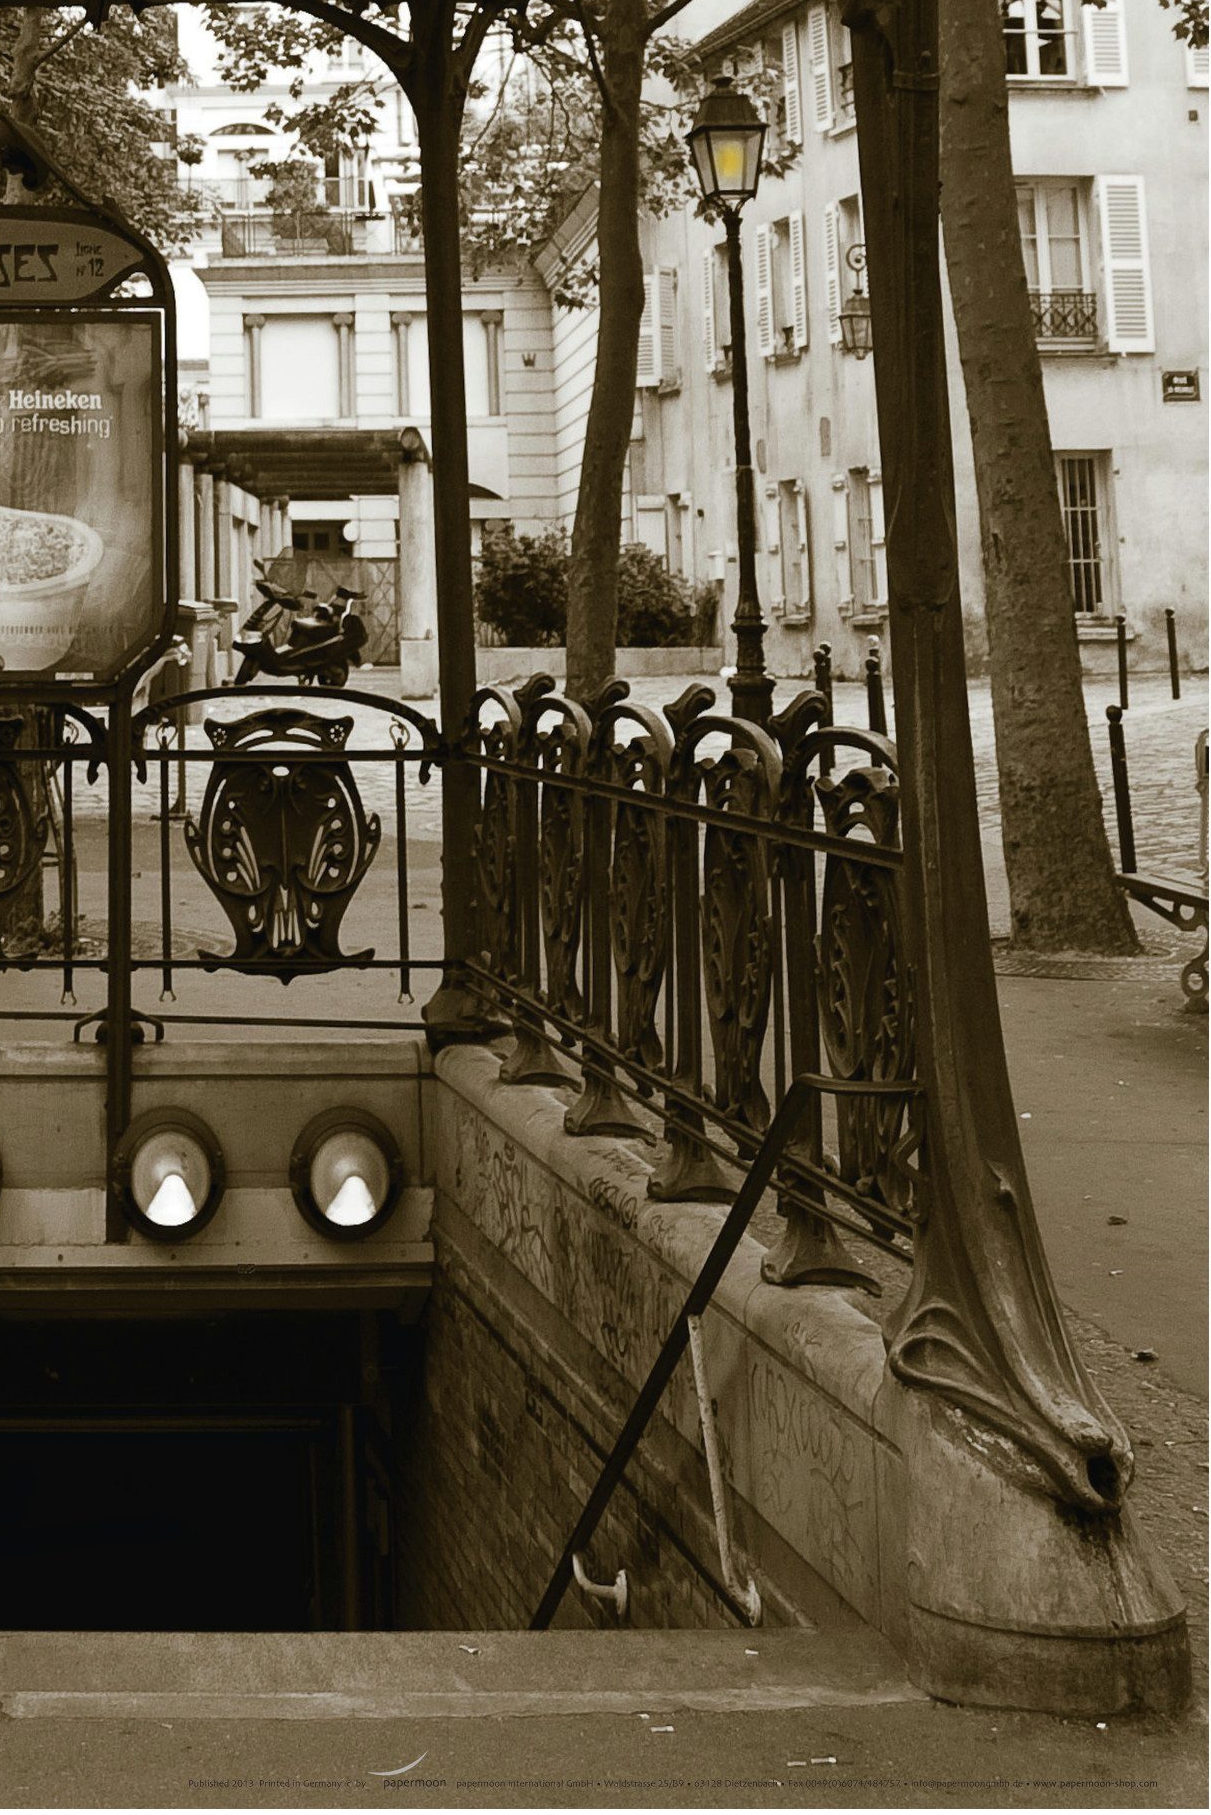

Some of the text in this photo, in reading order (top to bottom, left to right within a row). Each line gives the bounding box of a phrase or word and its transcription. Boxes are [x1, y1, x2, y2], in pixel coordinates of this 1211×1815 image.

[88, 258, 104, 277] 12
[8, 390, 102, 411] Heineken
[10, 413, 112, 439] refreshing
